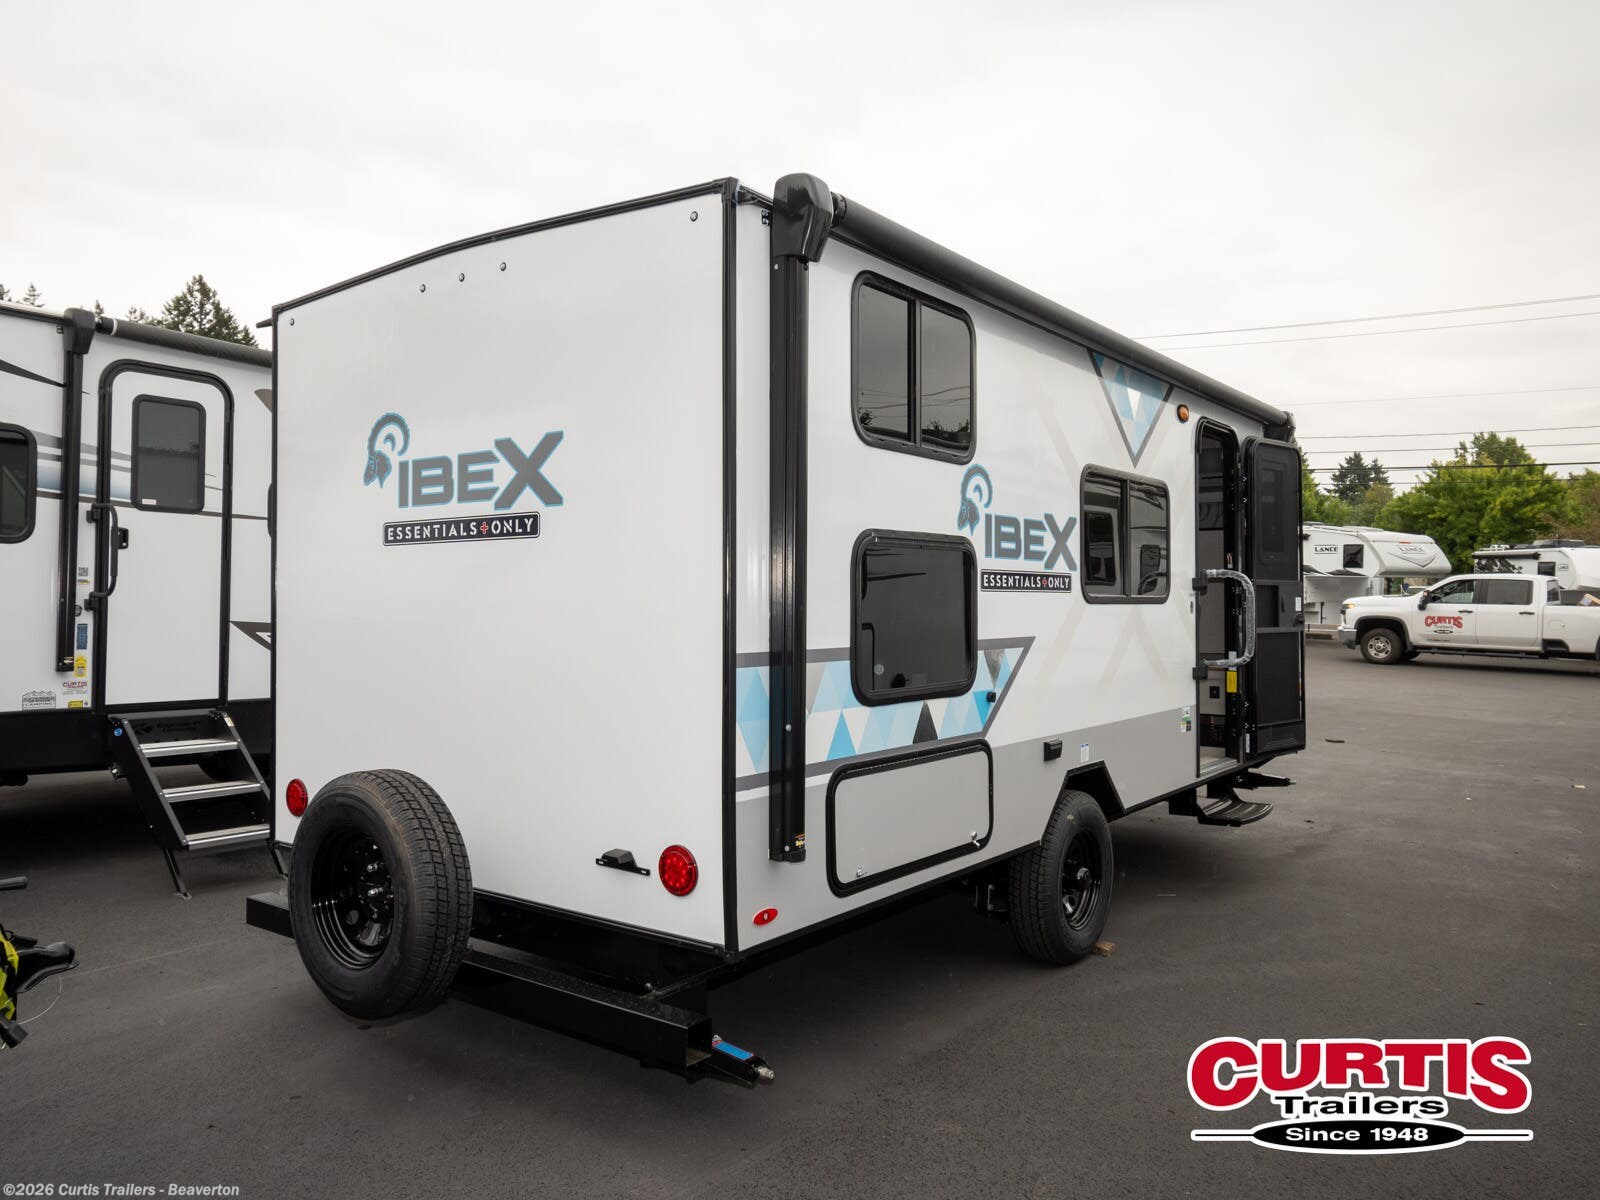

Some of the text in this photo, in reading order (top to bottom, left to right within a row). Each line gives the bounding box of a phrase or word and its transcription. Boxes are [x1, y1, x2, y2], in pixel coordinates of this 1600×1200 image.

[398, 430, 564, 511] IBEX
[387, 517, 533, 541] ESSENTIALS ONLY
[984, 512, 1078, 572] IBEX
[983, 574, 1070, 588] ESSENTIALS ONLY
[1424, 615, 1463, 628] CURTIS
